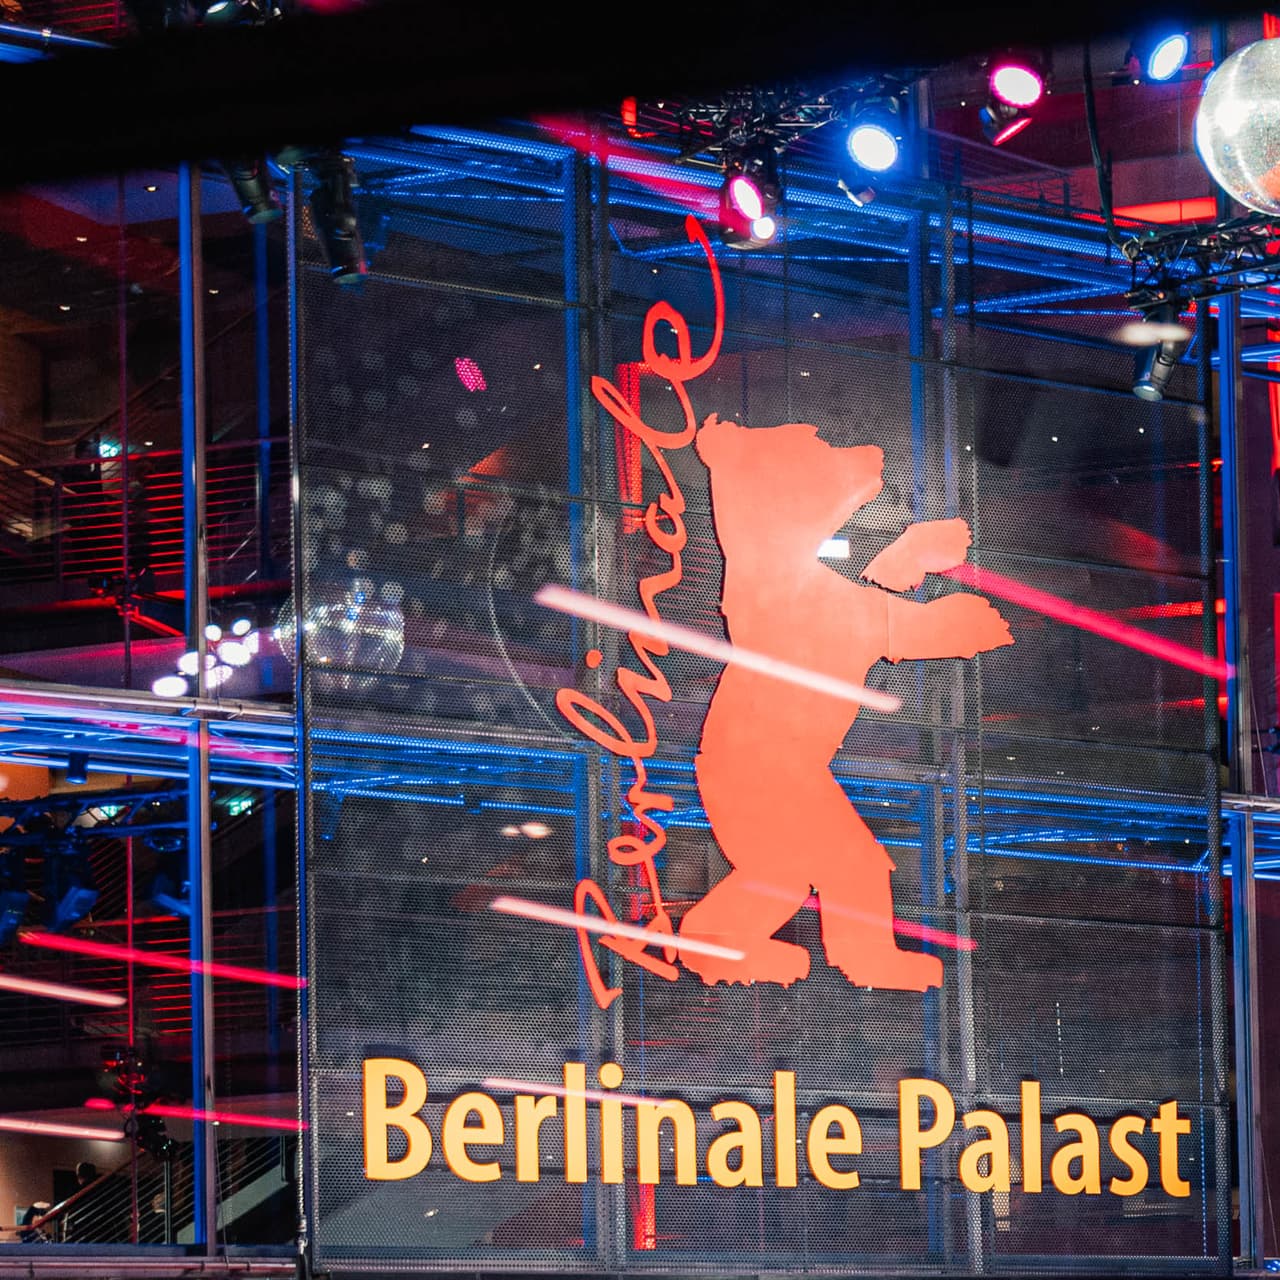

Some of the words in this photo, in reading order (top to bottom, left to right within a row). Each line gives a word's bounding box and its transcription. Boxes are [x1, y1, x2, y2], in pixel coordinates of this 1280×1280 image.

[556, 214, 725, 1010] Berlinale
[362, 1057, 865, 1191] Berlinale
[898, 1077, 1193, 1198] Palast
